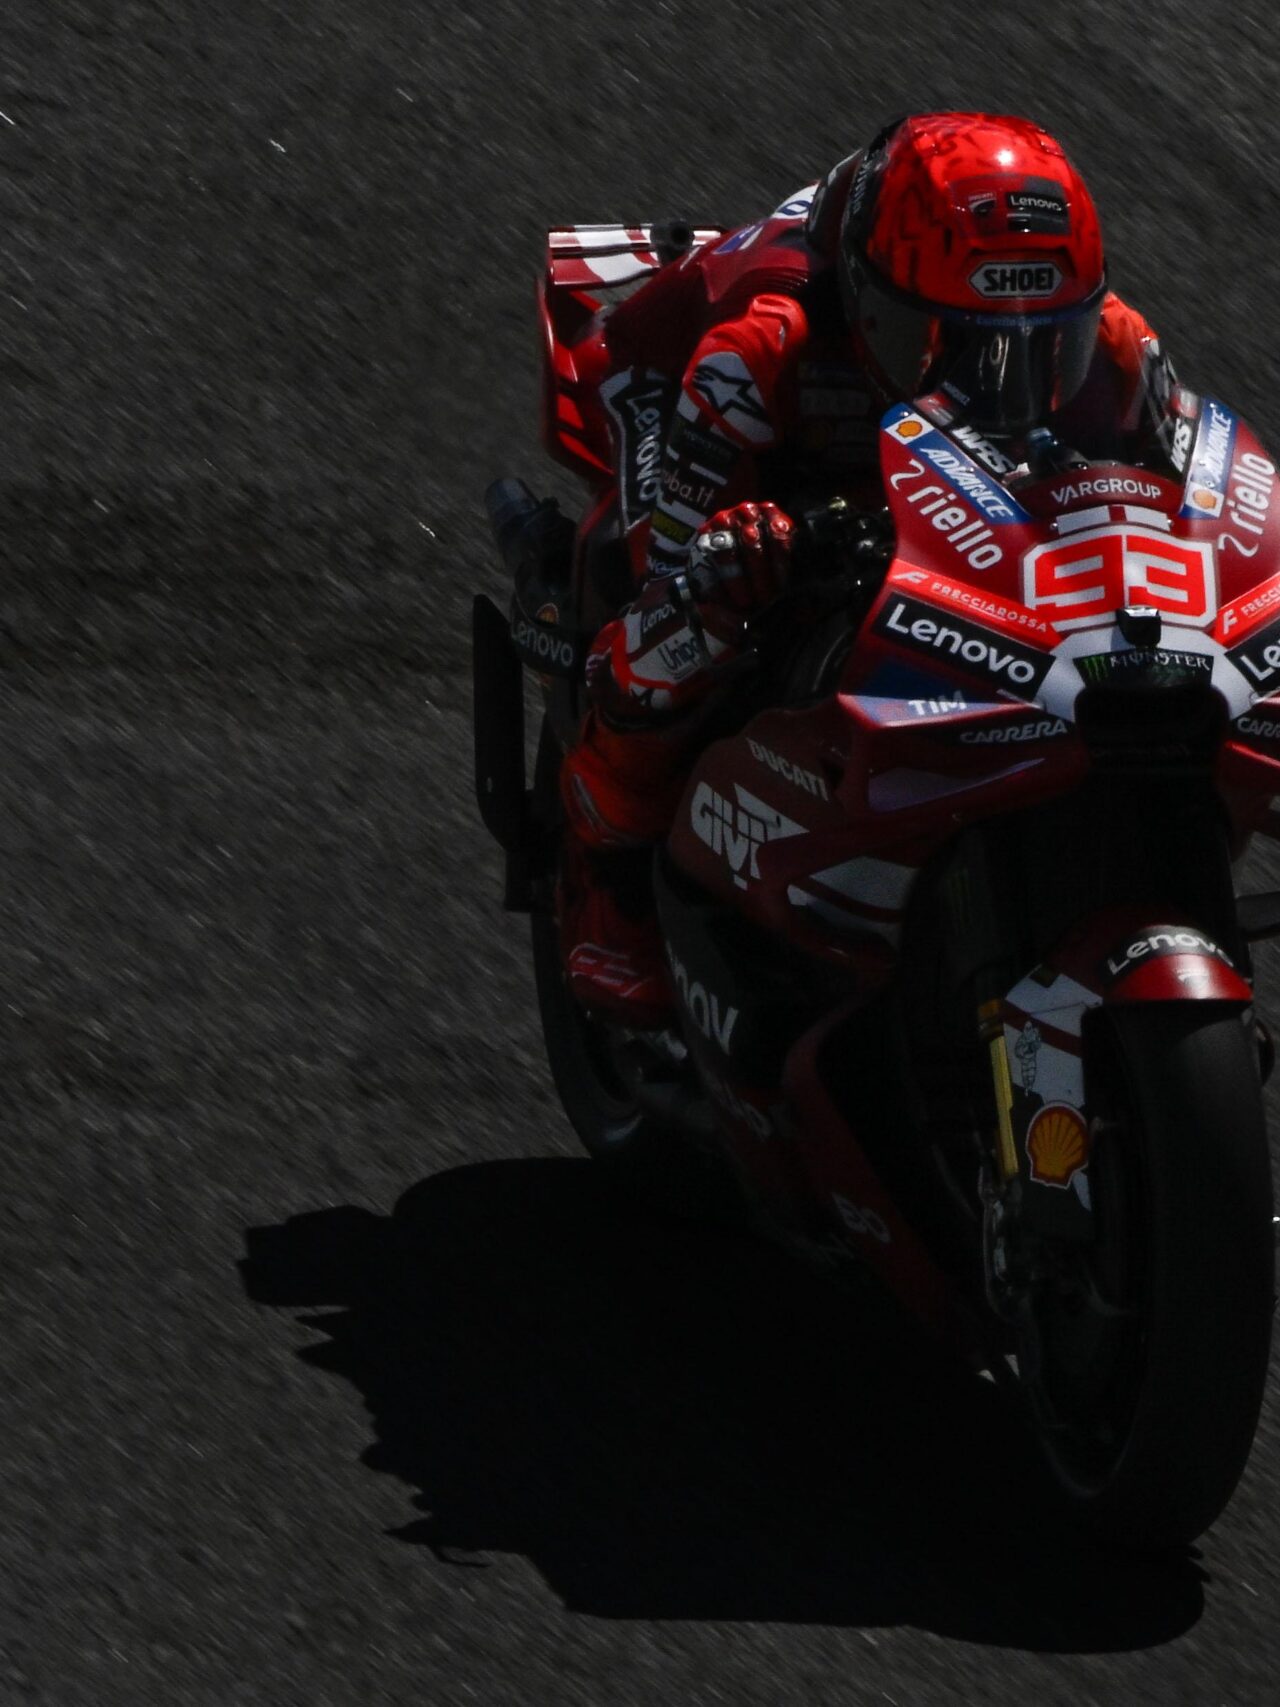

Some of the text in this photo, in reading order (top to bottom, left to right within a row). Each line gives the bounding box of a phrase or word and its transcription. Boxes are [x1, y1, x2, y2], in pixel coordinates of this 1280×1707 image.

[1010, 194, 1063, 212] Lenovo
[983, 267, 1054, 293] SHOEI
[626, 387, 664, 502] Lenovo
[920, 446, 1015, 519] ADVANCE
[1230, 451, 1276, 536] riello
[906, 485, 1003, 570] riello
[930, 581, 1049, 633] FRECCIAROSSA
[1033, 534, 1207, 623] 93
[511, 617, 574, 667] Lenovo
[885, 602, 1036, 684] Lenovo
[1110, 651, 1211, 672] MONSTER
[907, 690, 968, 716] TIM
[959, 720, 1069, 745] CARRERA
[746, 738, 833, 803] DUCATI
